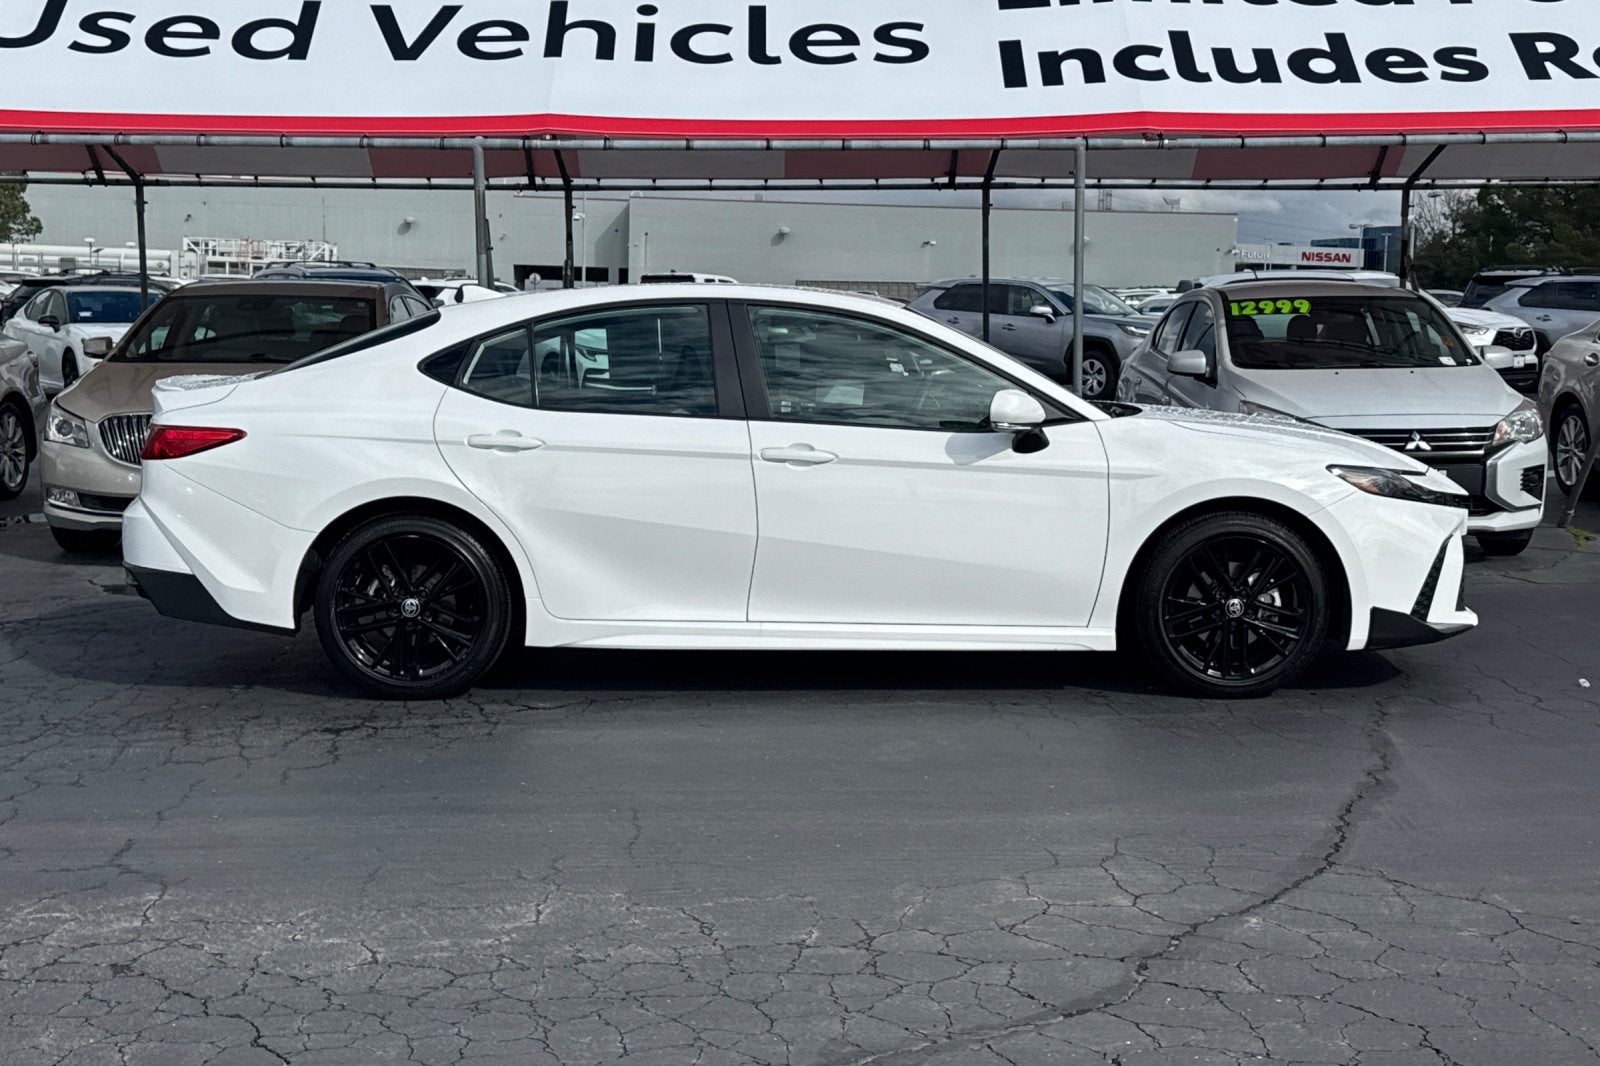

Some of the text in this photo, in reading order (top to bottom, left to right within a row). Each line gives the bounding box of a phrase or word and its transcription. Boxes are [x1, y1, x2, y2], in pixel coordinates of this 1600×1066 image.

[370, 1, 930, 65] Vehicles
[998, 30, 1600, 88] Includes R
[1301, 251, 1351, 263] NISSAN
[1230, 299, 1312, 316] 12999
